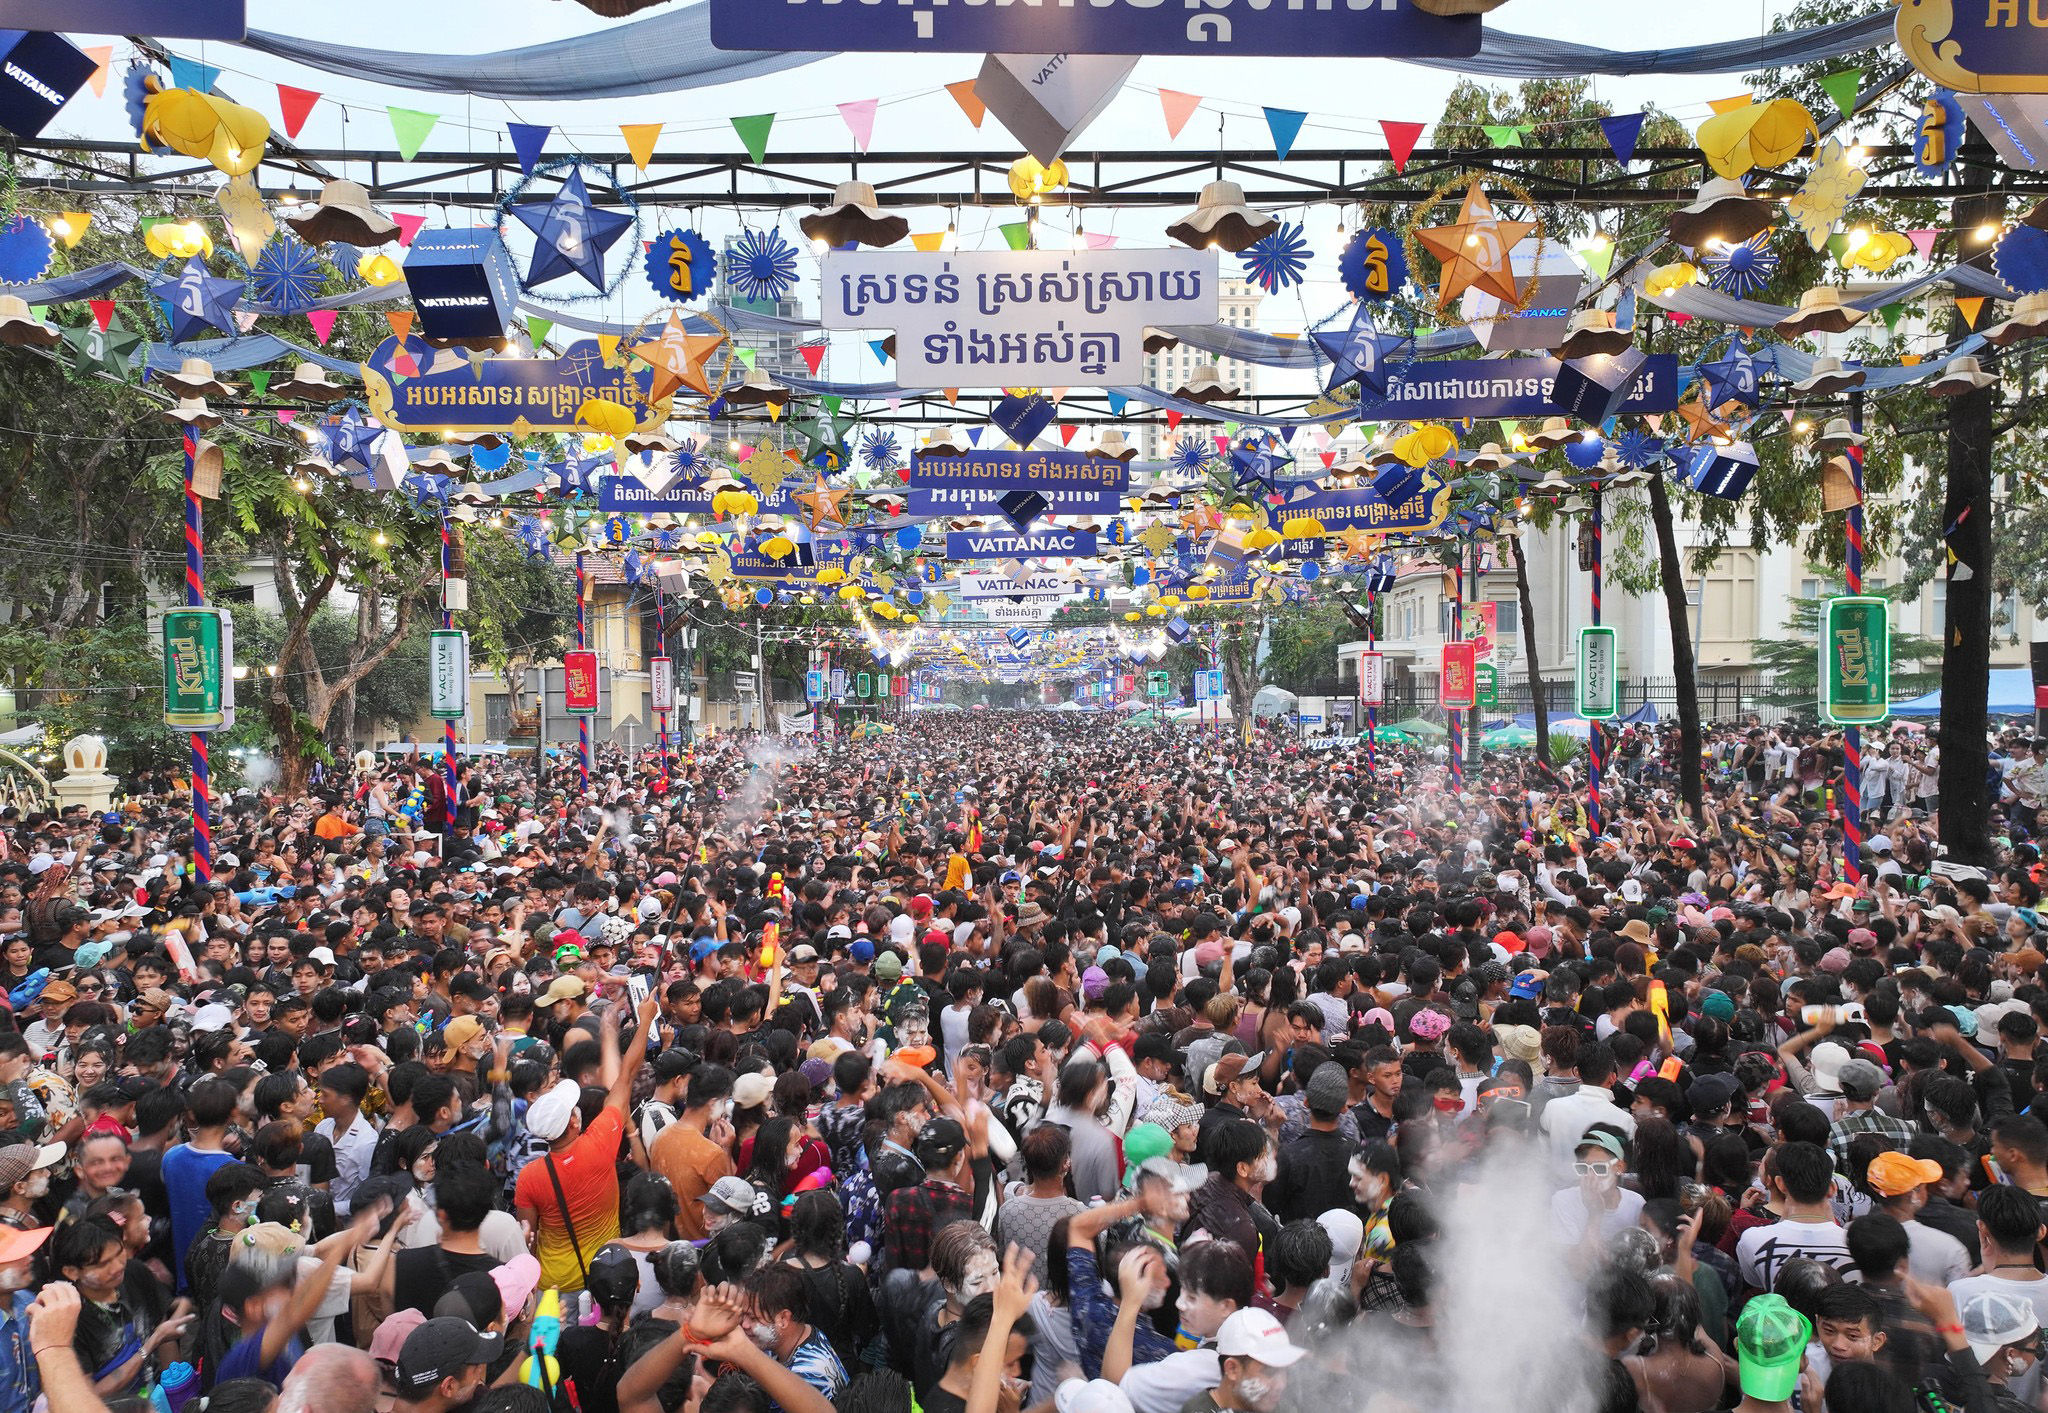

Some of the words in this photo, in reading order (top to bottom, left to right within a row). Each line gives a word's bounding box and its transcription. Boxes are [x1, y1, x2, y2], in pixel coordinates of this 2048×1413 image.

[4, 62, 66, 106] VATTANAC
[419, 296, 489, 308] VATTANAC
[841, 262, 960, 316] ស្រទន់
[976, 260, 1201, 315] ស្រស់ស្រាយ
[924, 319, 1120, 375] ទាំងអស់គ្នា
[406, 386, 522, 406] អបអរសាទរ
[1572, 379, 1589, 412] VATTANAC
[1009, 397, 1040, 431] VATTANAC
[918, 461, 1021, 479] អបអរសាទរ
[968, 535, 1075, 553] VATTANAC
[170, 635, 205, 696] Krud
[438, 643, 447, 702] V-ACTIVE
[1589, 641, 1598, 699] V-ACTIVE
[1837, 627, 1869, 687] Krud
[570, 669, 587, 699] Krud
[1447, 661, 1464, 691] Krud
